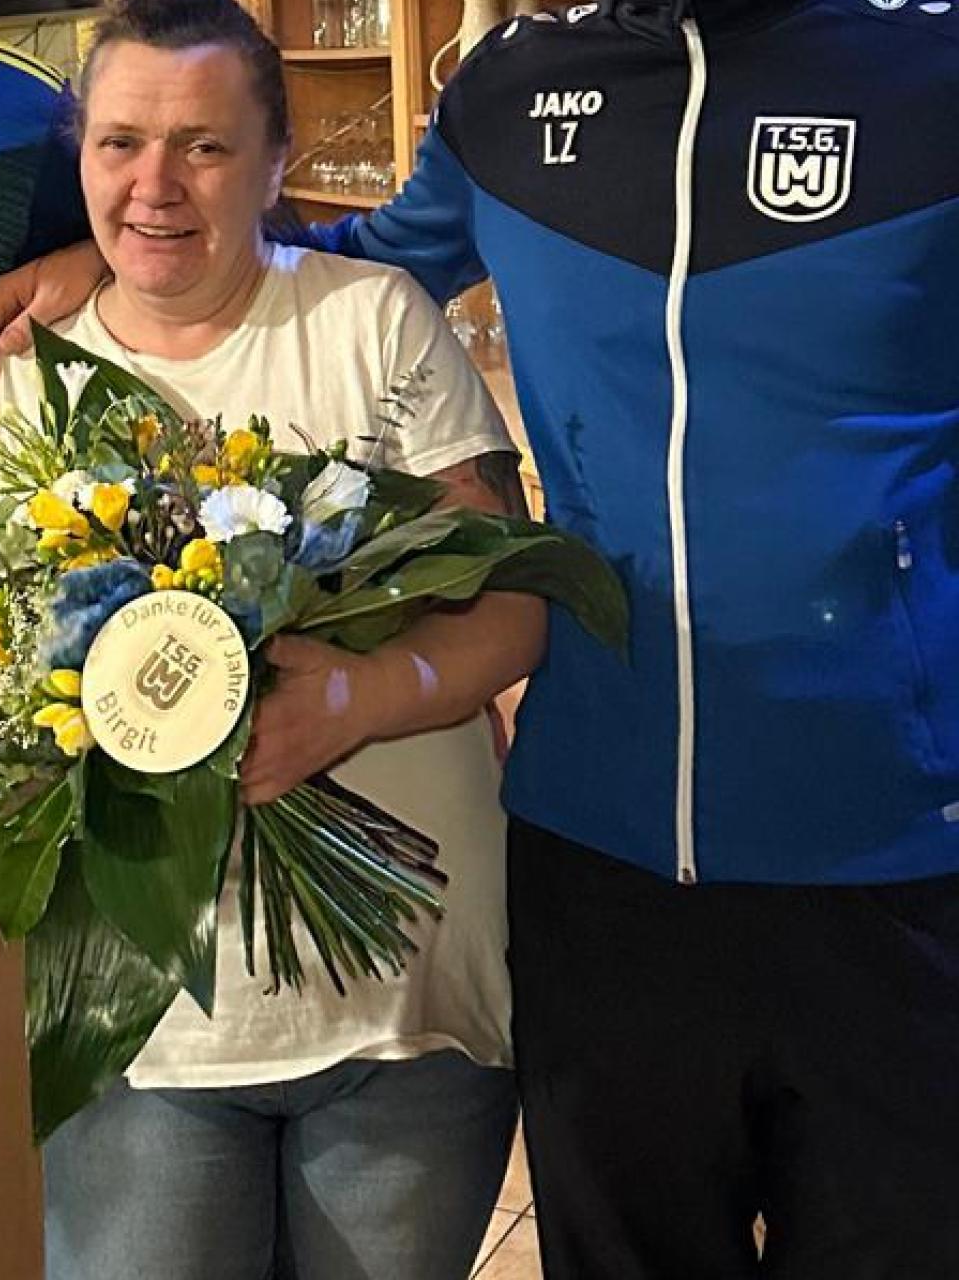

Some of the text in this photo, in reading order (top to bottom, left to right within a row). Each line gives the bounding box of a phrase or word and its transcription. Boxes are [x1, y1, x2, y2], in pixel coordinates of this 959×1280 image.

[529, 90, 603, 118] JAKO
[542, 122, 578, 165] LZ
[121, 594, 188, 629] Danke
[191, 601, 221, 630] für
[223, 648, 247, 712] Jahre
[95, 690, 160, 754] Birgit
